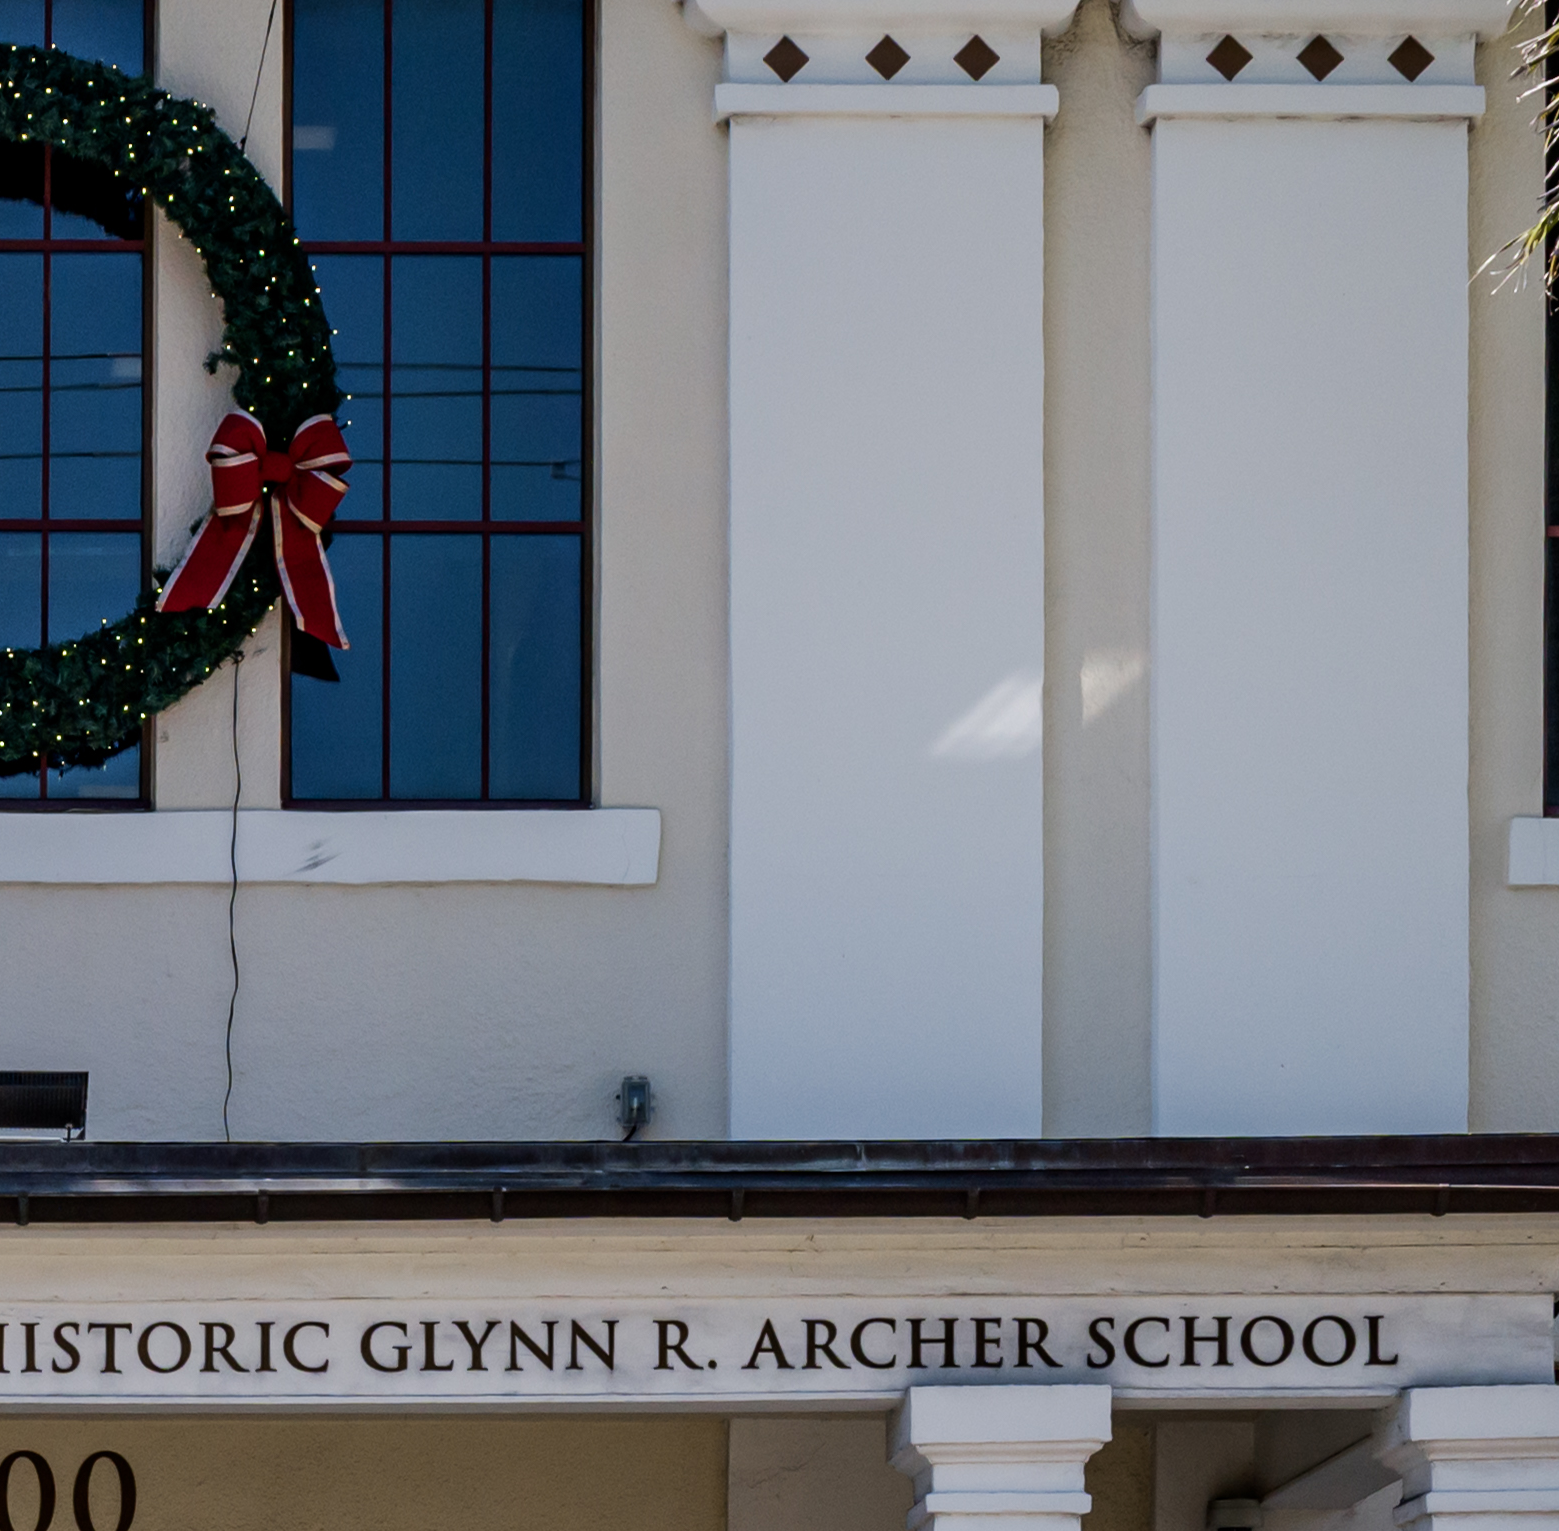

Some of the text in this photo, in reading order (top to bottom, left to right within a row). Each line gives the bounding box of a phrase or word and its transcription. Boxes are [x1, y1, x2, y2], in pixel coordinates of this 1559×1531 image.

[360, 1319, 620, 1373] GLYNN
[652, 1319, 718, 1372] R.
[741, 1317, 1064, 1371] ARCHER
[1086, 1315, 1399, 1370] SCHOOL
